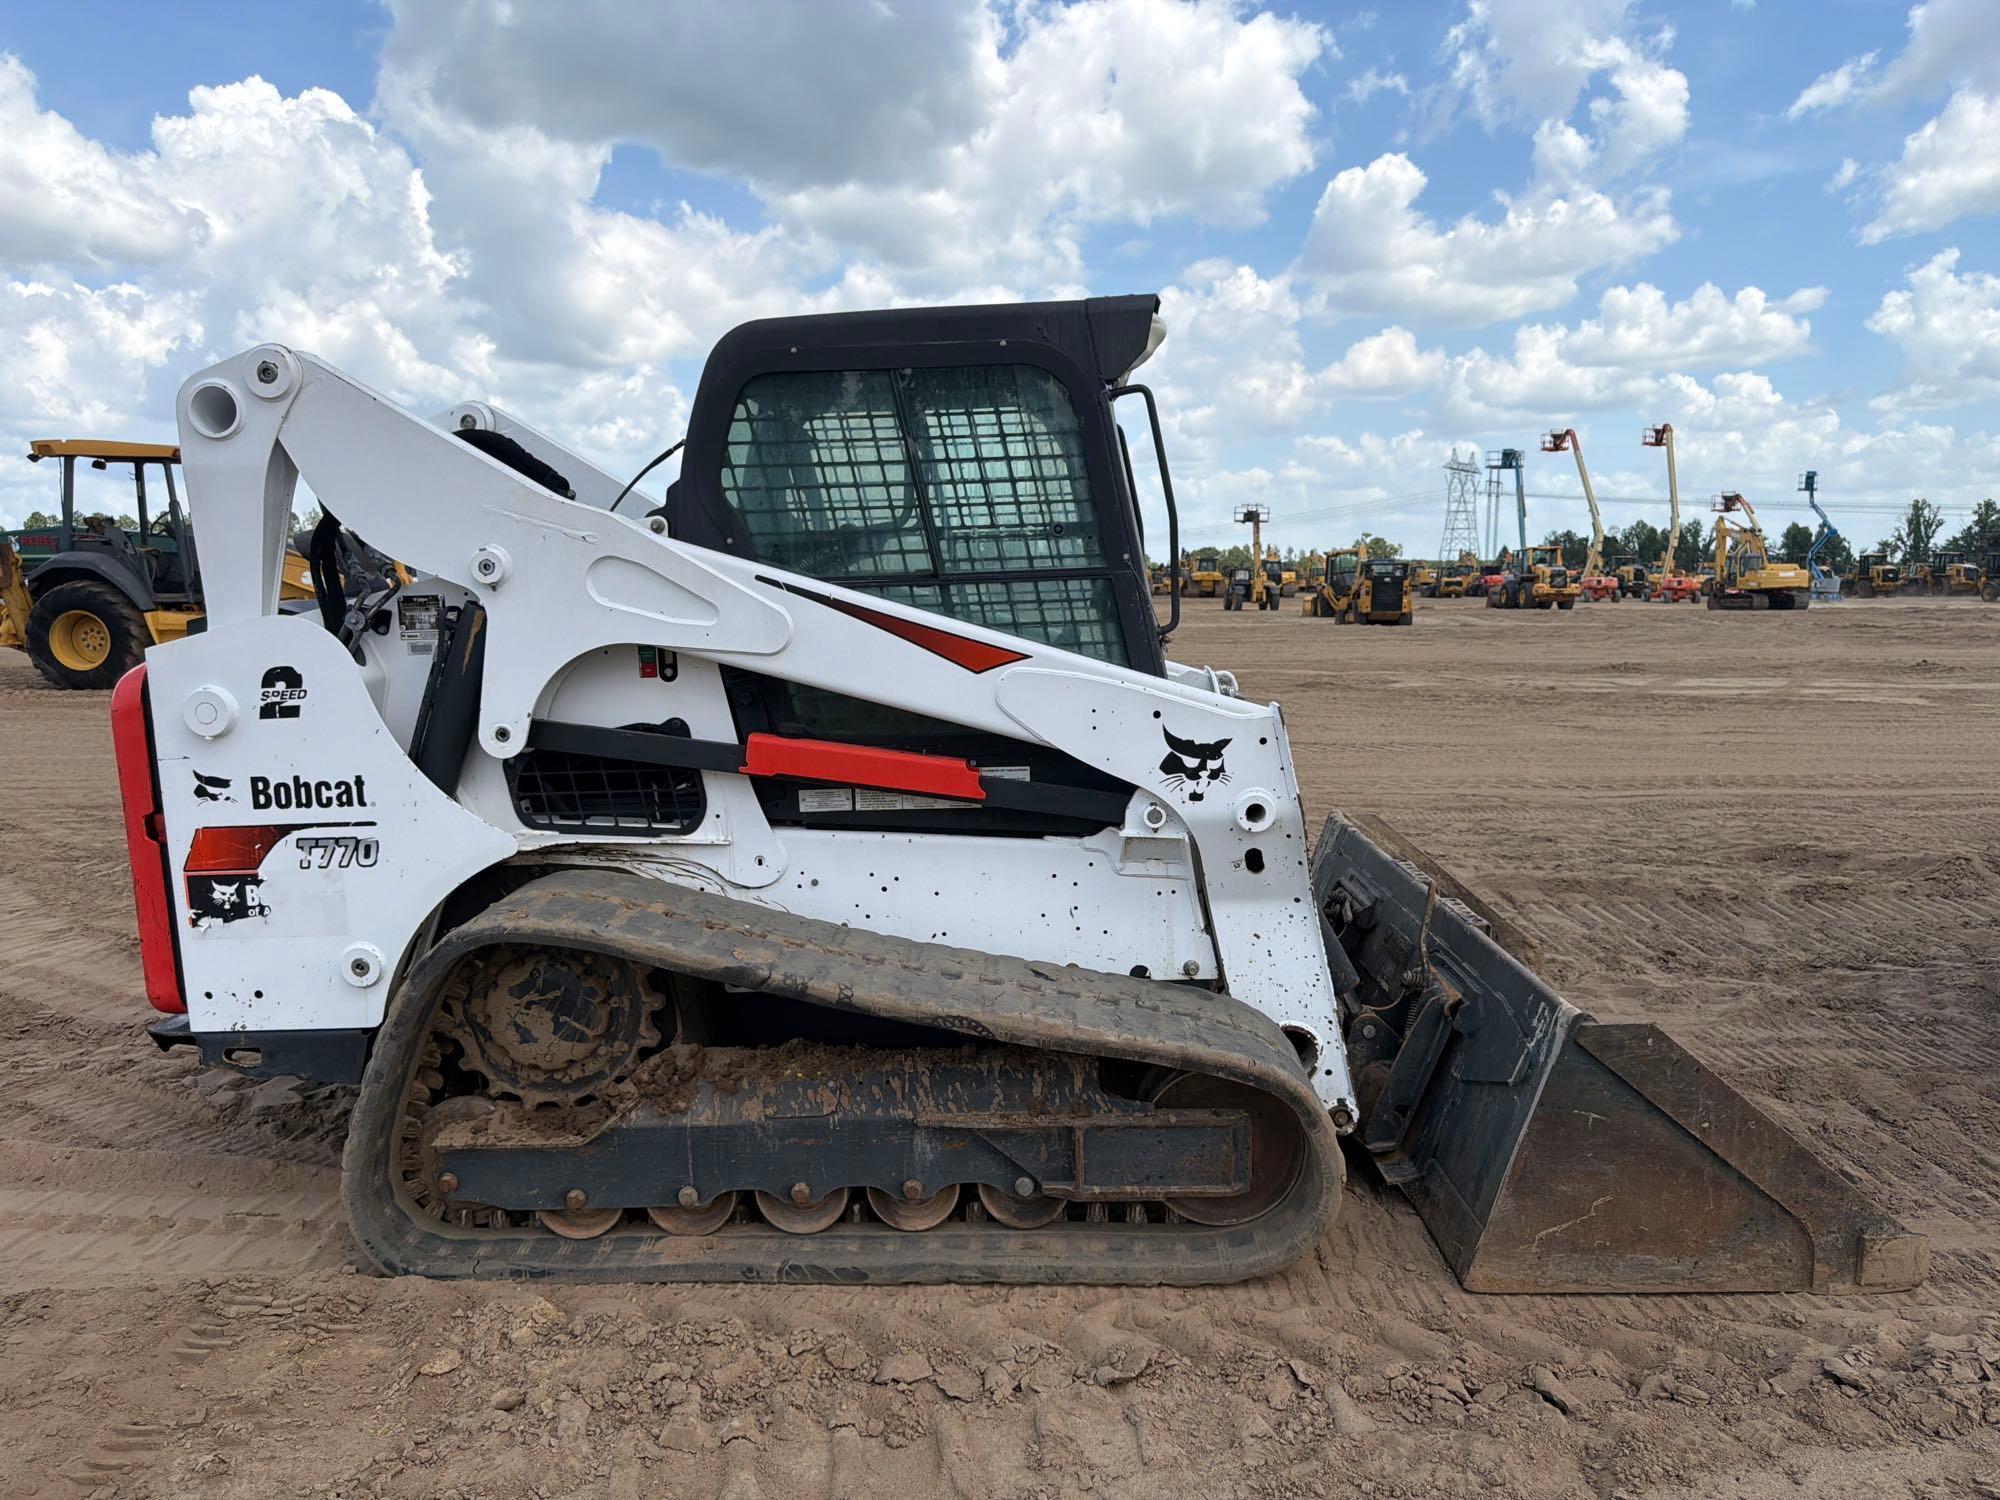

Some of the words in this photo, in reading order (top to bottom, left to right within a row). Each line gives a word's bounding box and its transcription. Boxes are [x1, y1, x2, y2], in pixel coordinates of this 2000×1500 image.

[259, 665, 303, 720] 2
[260, 689, 308, 702] SPEED
[250, 775, 367, 809] Bobcat
[296, 836, 379, 869] T770
[245, 884, 261, 906] B
[248, 906, 260, 917] of
